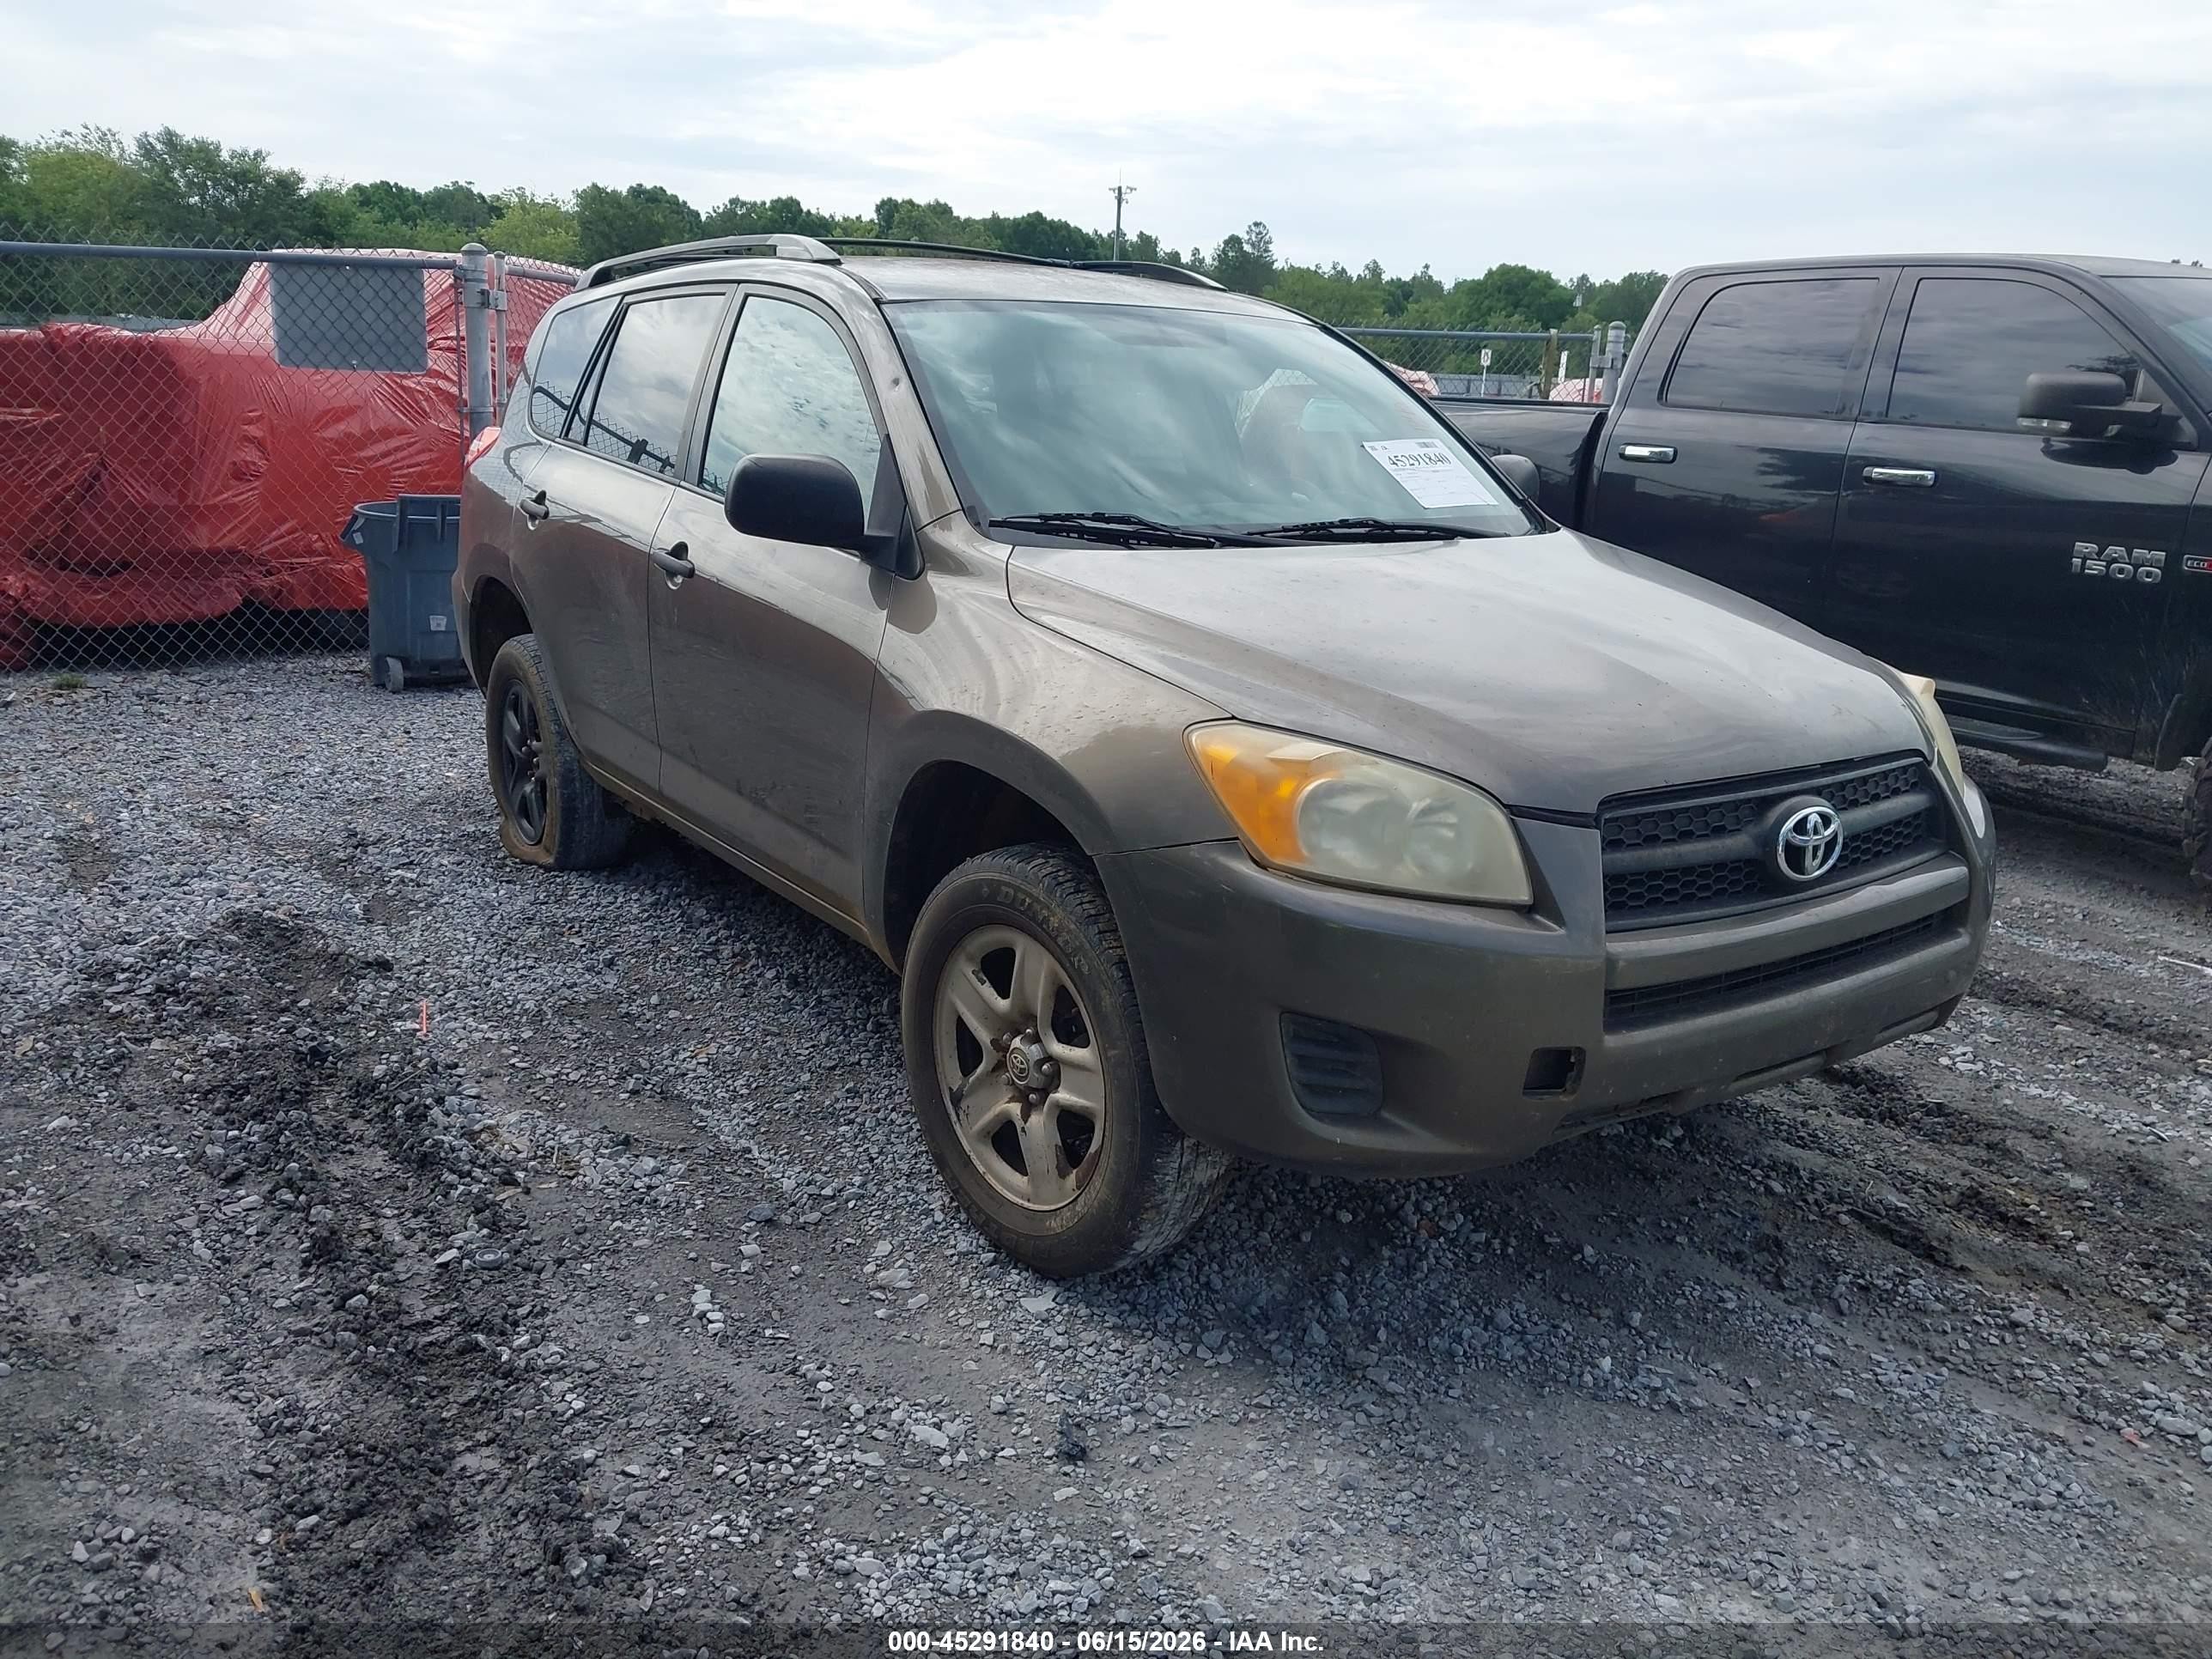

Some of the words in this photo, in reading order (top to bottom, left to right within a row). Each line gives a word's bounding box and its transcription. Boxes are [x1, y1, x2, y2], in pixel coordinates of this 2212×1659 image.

[1388, 453, 1451, 467] 45291840
[2072, 542, 2166, 568] RAM
[2071, 557, 2162, 584] 1500
